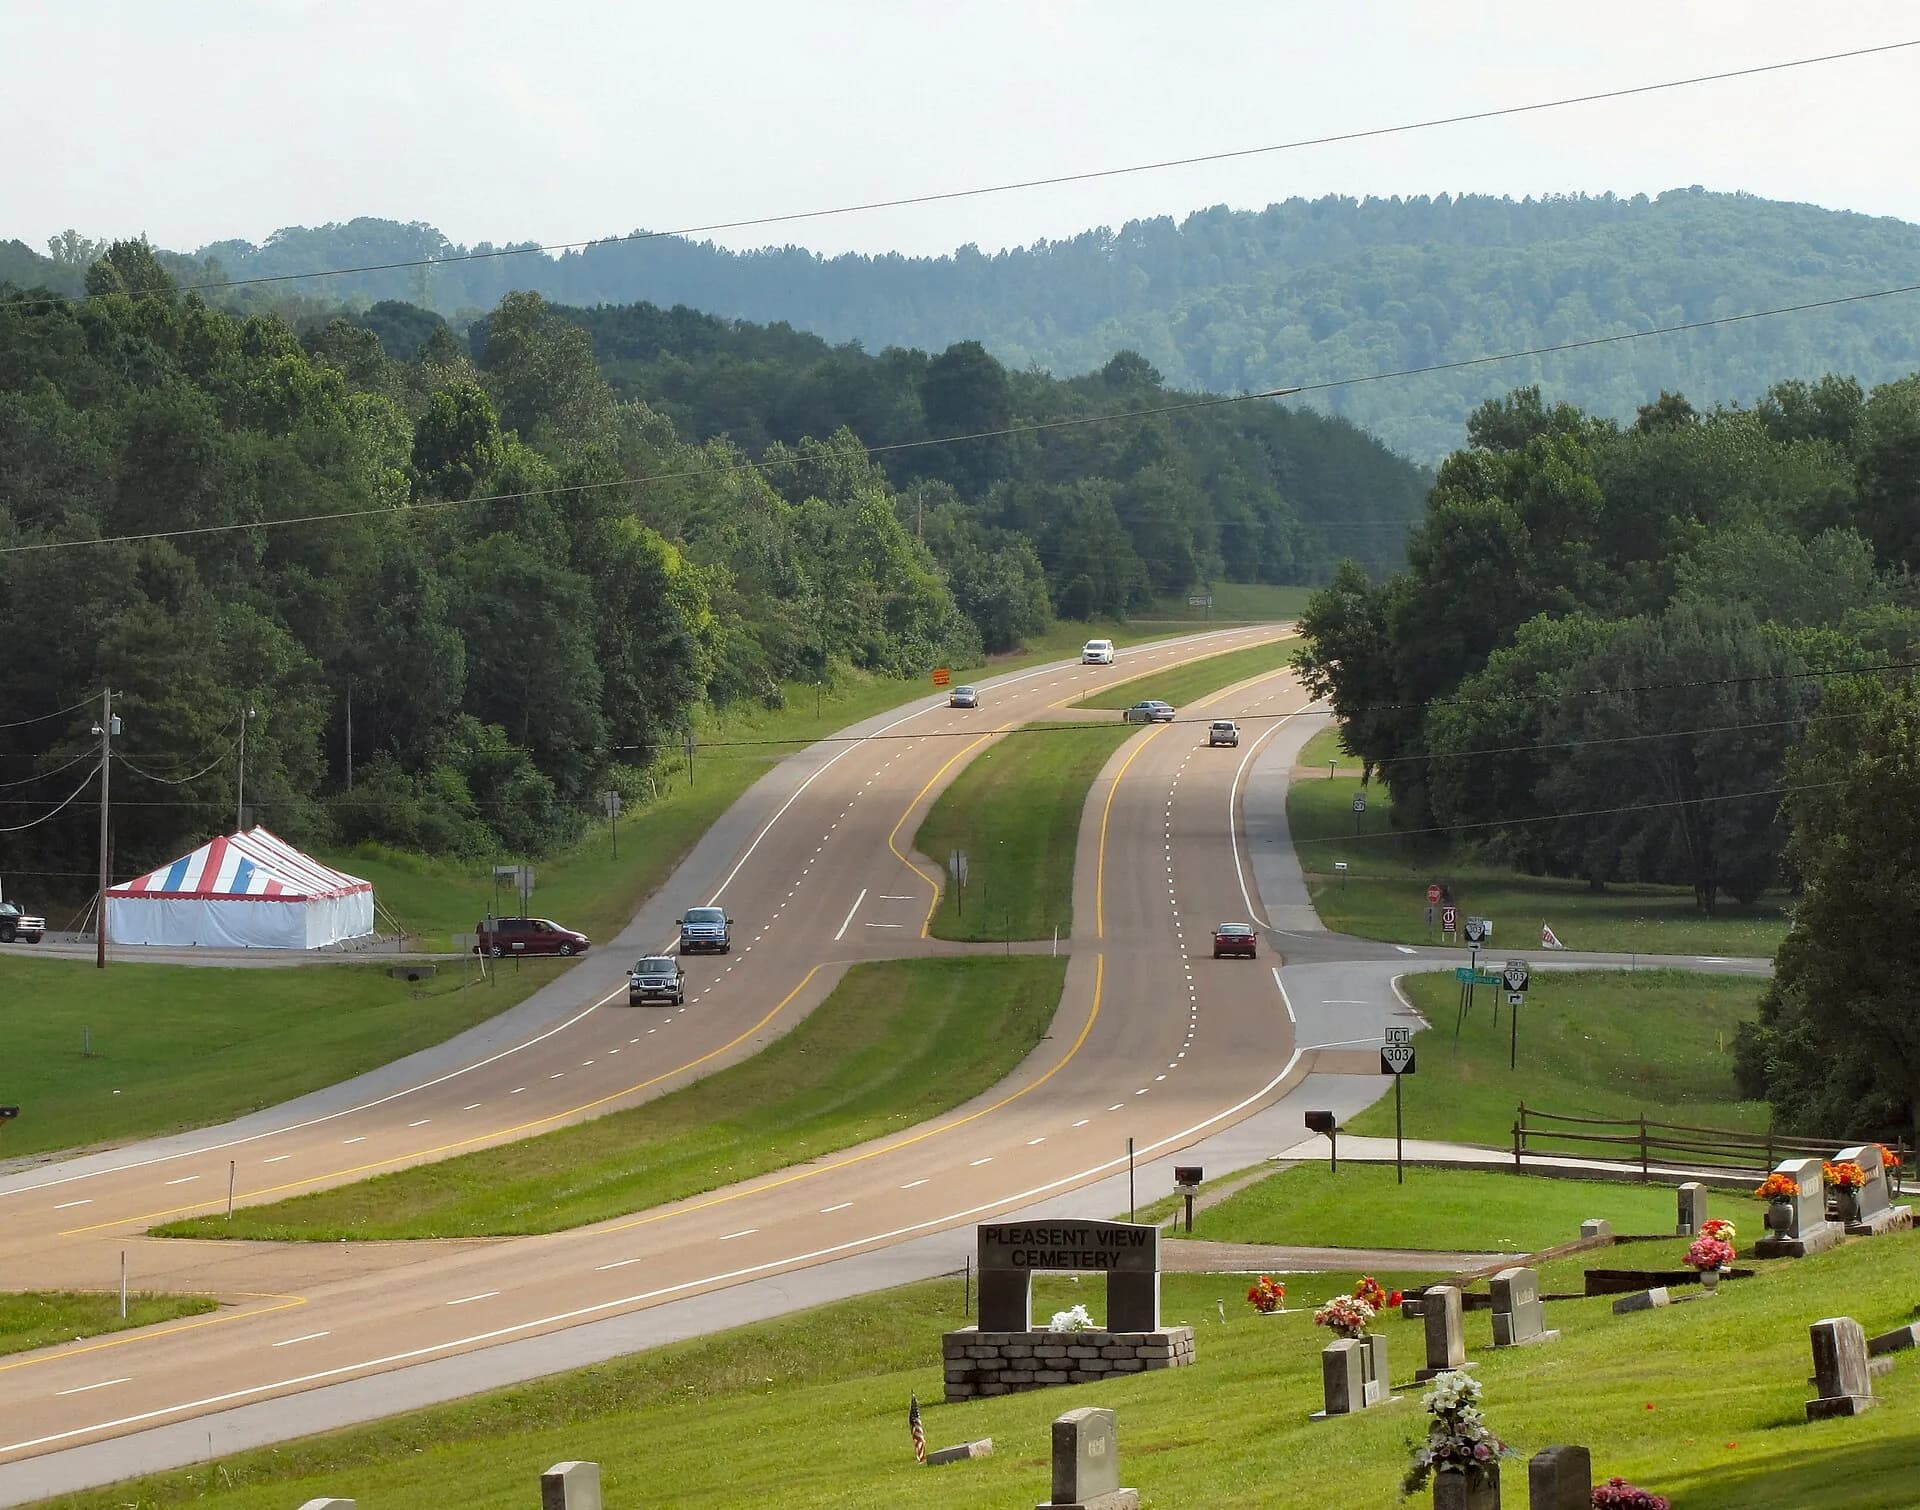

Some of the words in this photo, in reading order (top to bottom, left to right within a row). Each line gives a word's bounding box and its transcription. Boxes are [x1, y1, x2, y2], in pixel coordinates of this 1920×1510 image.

[1469, 926, 1482, 934] 303
[1508, 972, 1524, 981] 303
[1388, 1030, 1408, 1042] JCT
[1388, 1049, 1409, 1061] 303
[985, 1228, 1090, 1246] PLEASENT
[1096, 1229, 1148, 1247] VIEW
[1011, 1249, 1121, 1268] CEMETERY
